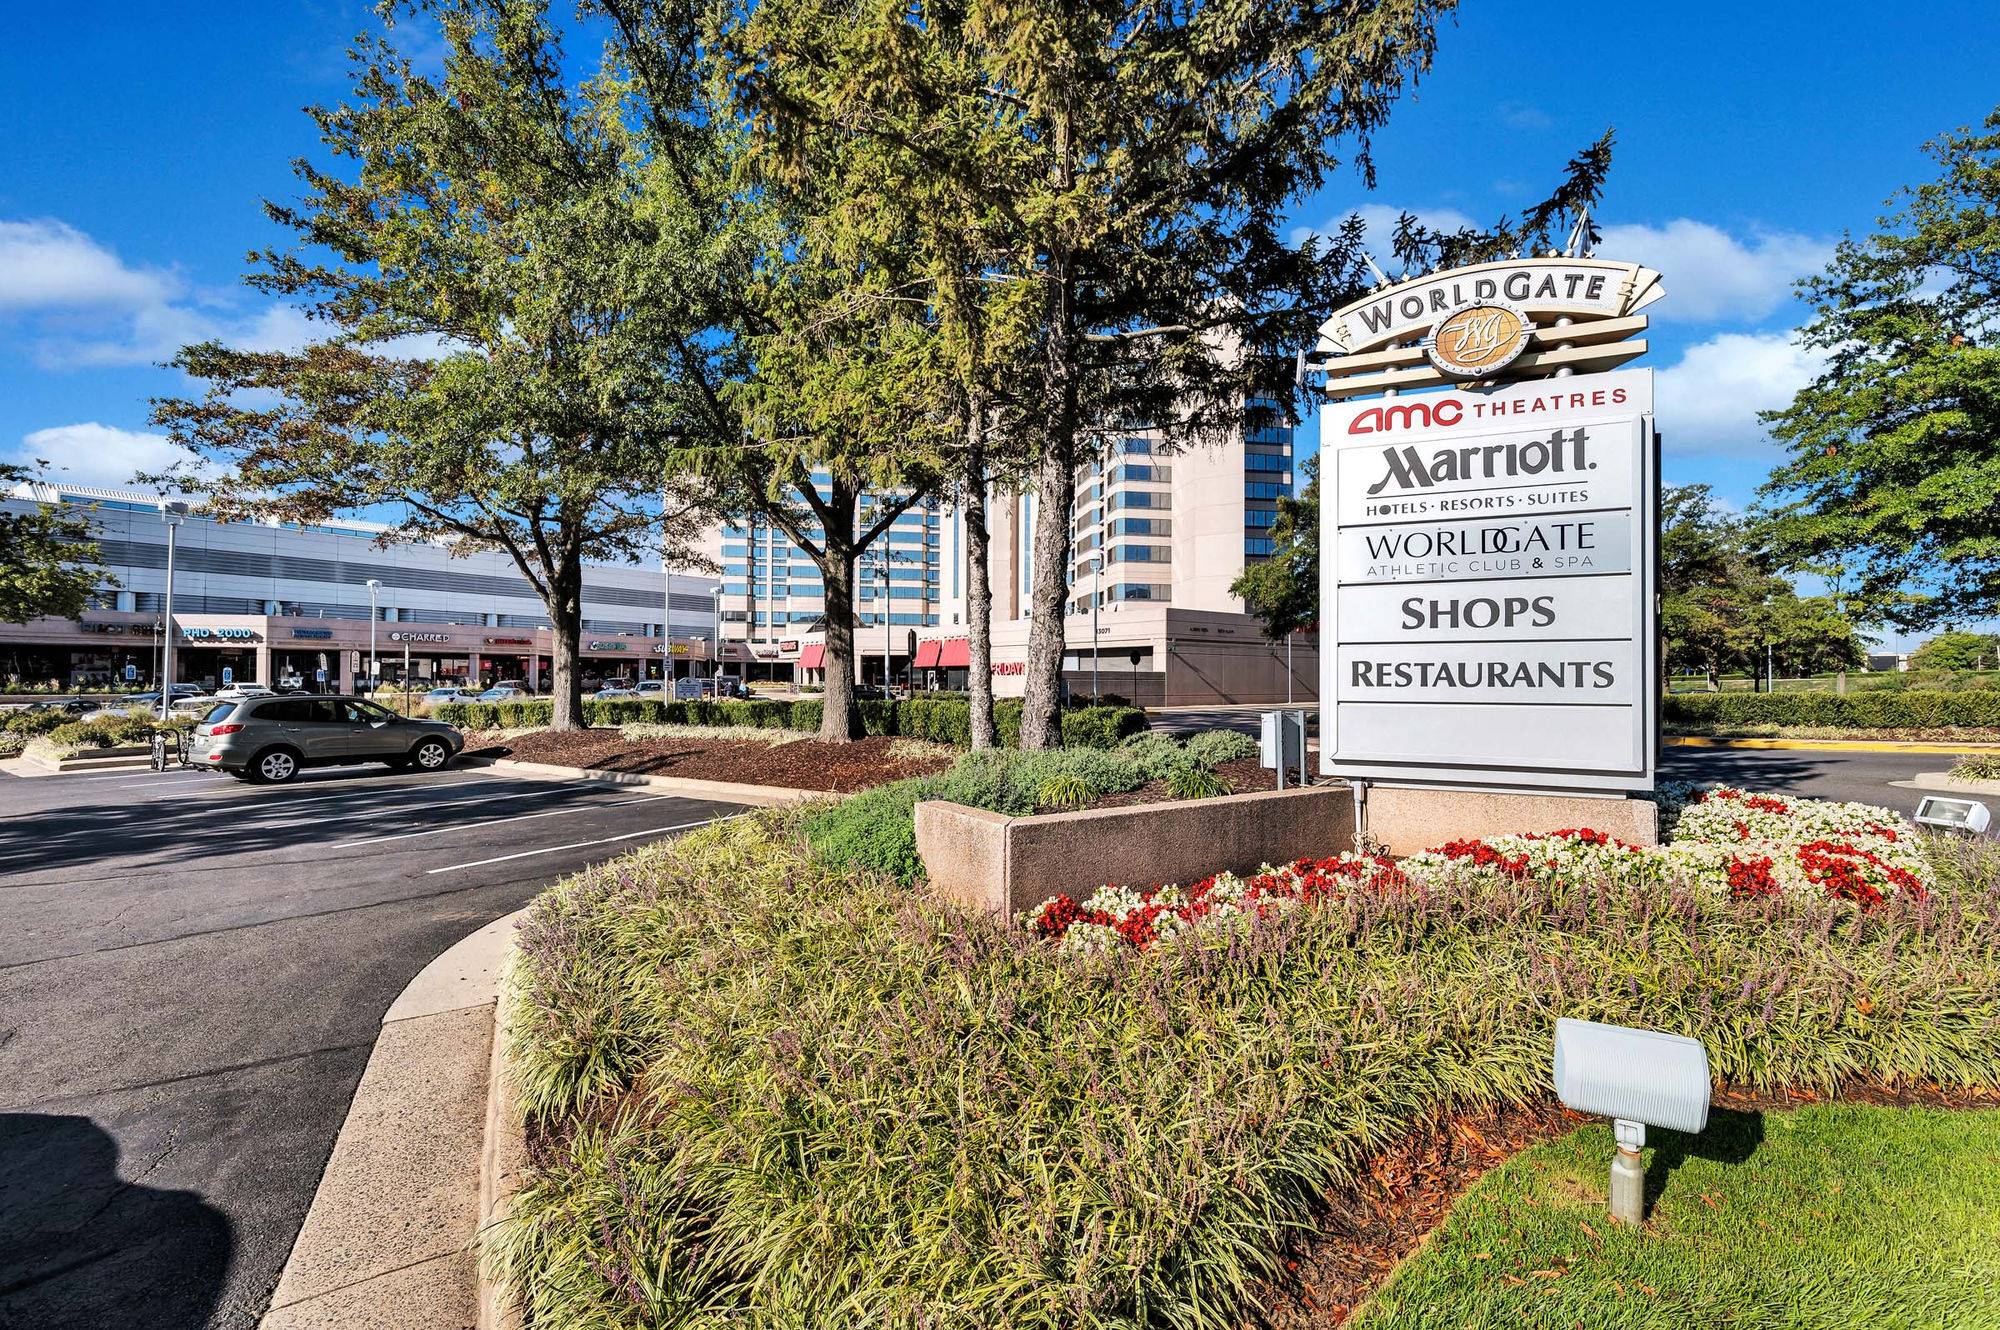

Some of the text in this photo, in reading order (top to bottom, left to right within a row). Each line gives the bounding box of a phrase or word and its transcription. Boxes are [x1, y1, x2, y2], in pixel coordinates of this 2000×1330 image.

[1359, 271, 1605, 334] WORLDGATE
[1473, 388, 1627, 418] THEATRES
[1366, 490, 1589, 516] HOTELS RESORTS SUITES
[1366, 522, 1595, 560] WORLDGATE
[1366, 555, 1594, 576] ATHLETIC CLUB & SPA
[1401, 596, 1556, 630] SHOPS
[216, 628, 252, 638] 2000
[401, 632, 450, 643] CHARRED
[1351, 660, 1615, 689] RESTAURANTS
